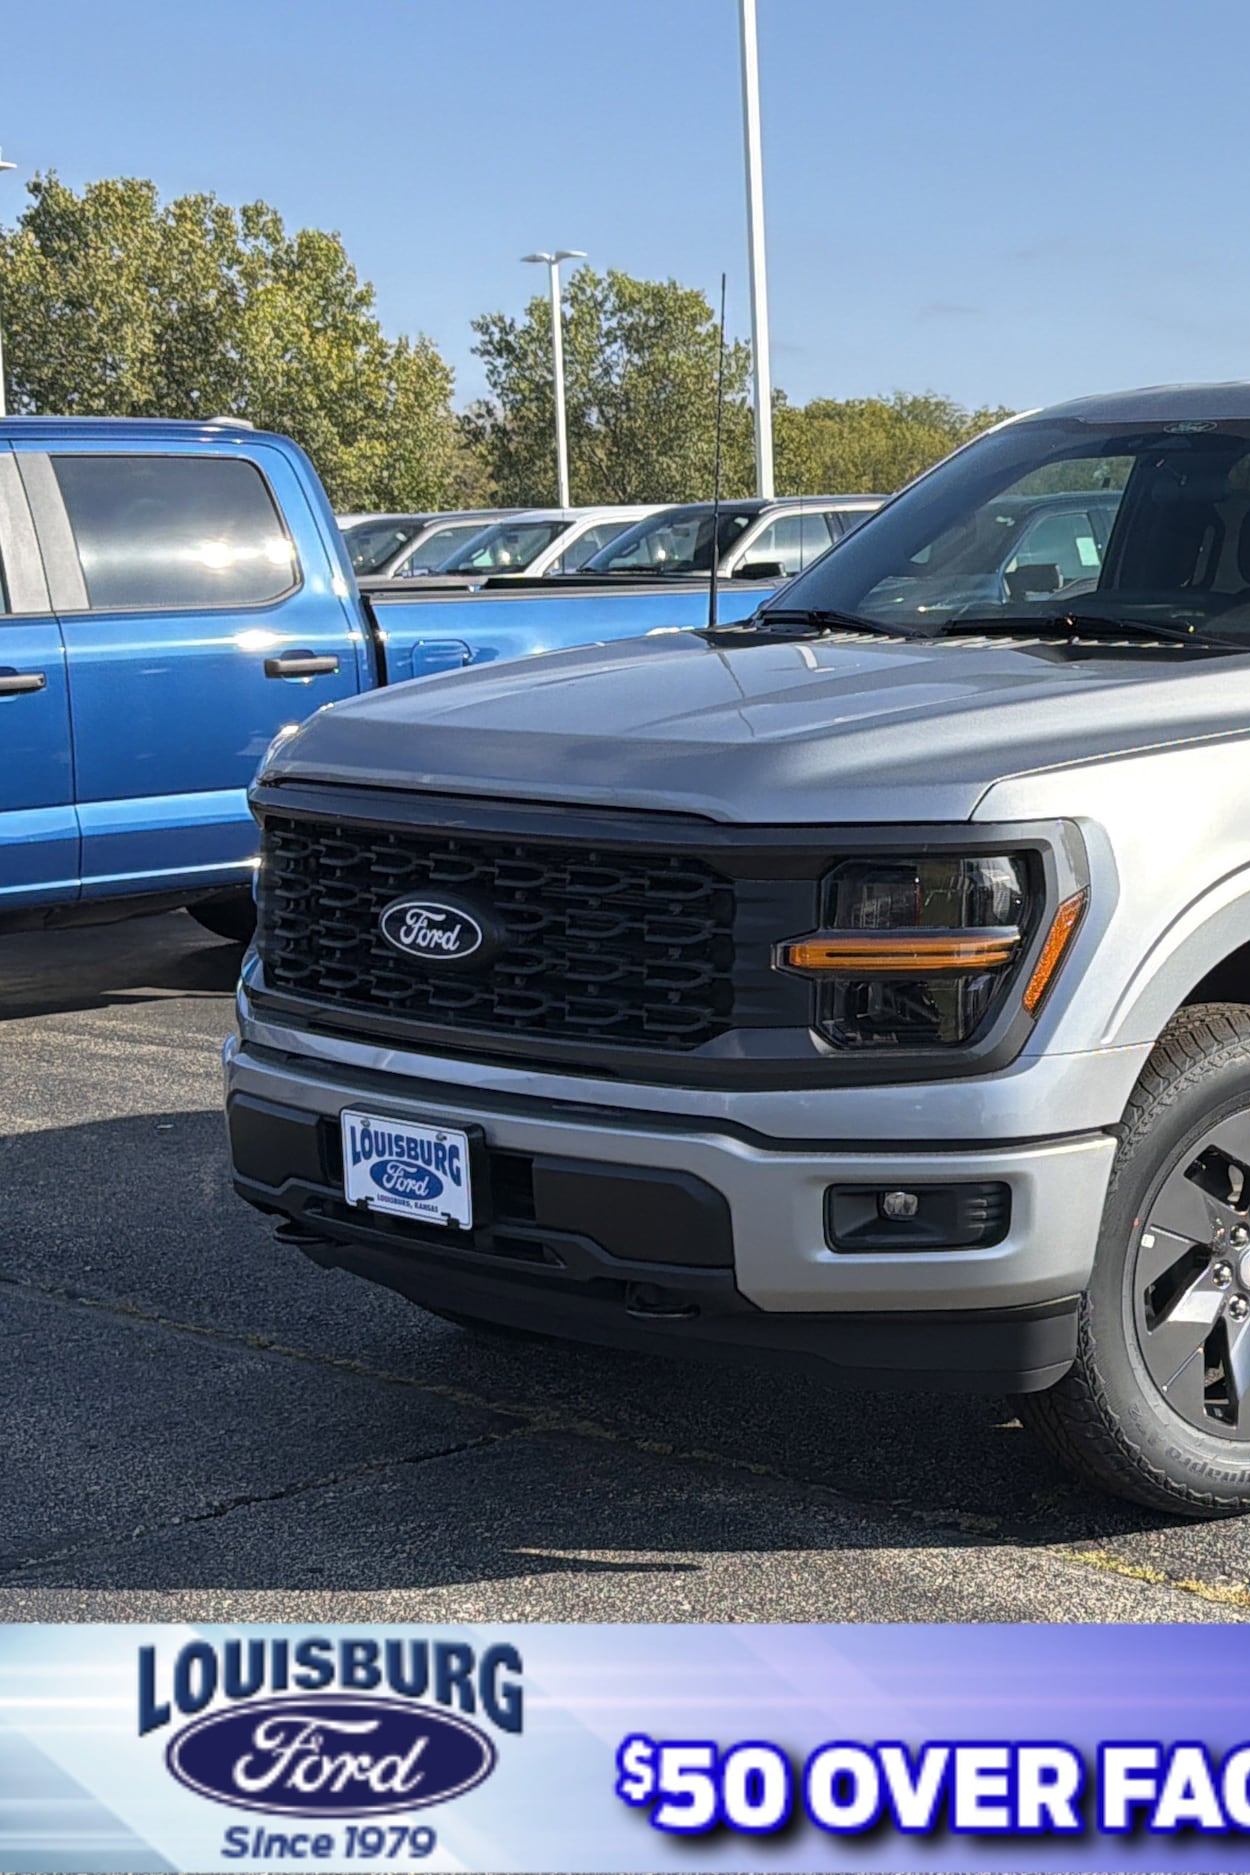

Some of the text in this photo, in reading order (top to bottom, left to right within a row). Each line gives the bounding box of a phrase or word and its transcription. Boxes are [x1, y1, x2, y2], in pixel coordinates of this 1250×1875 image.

[400, 908, 461, 951] Ford
[350, 1125, 461, 1187] LOUISBURG
[382, 1161, 429, 1196] Ford
[414, 1201, 439, 1213] KANSAS
